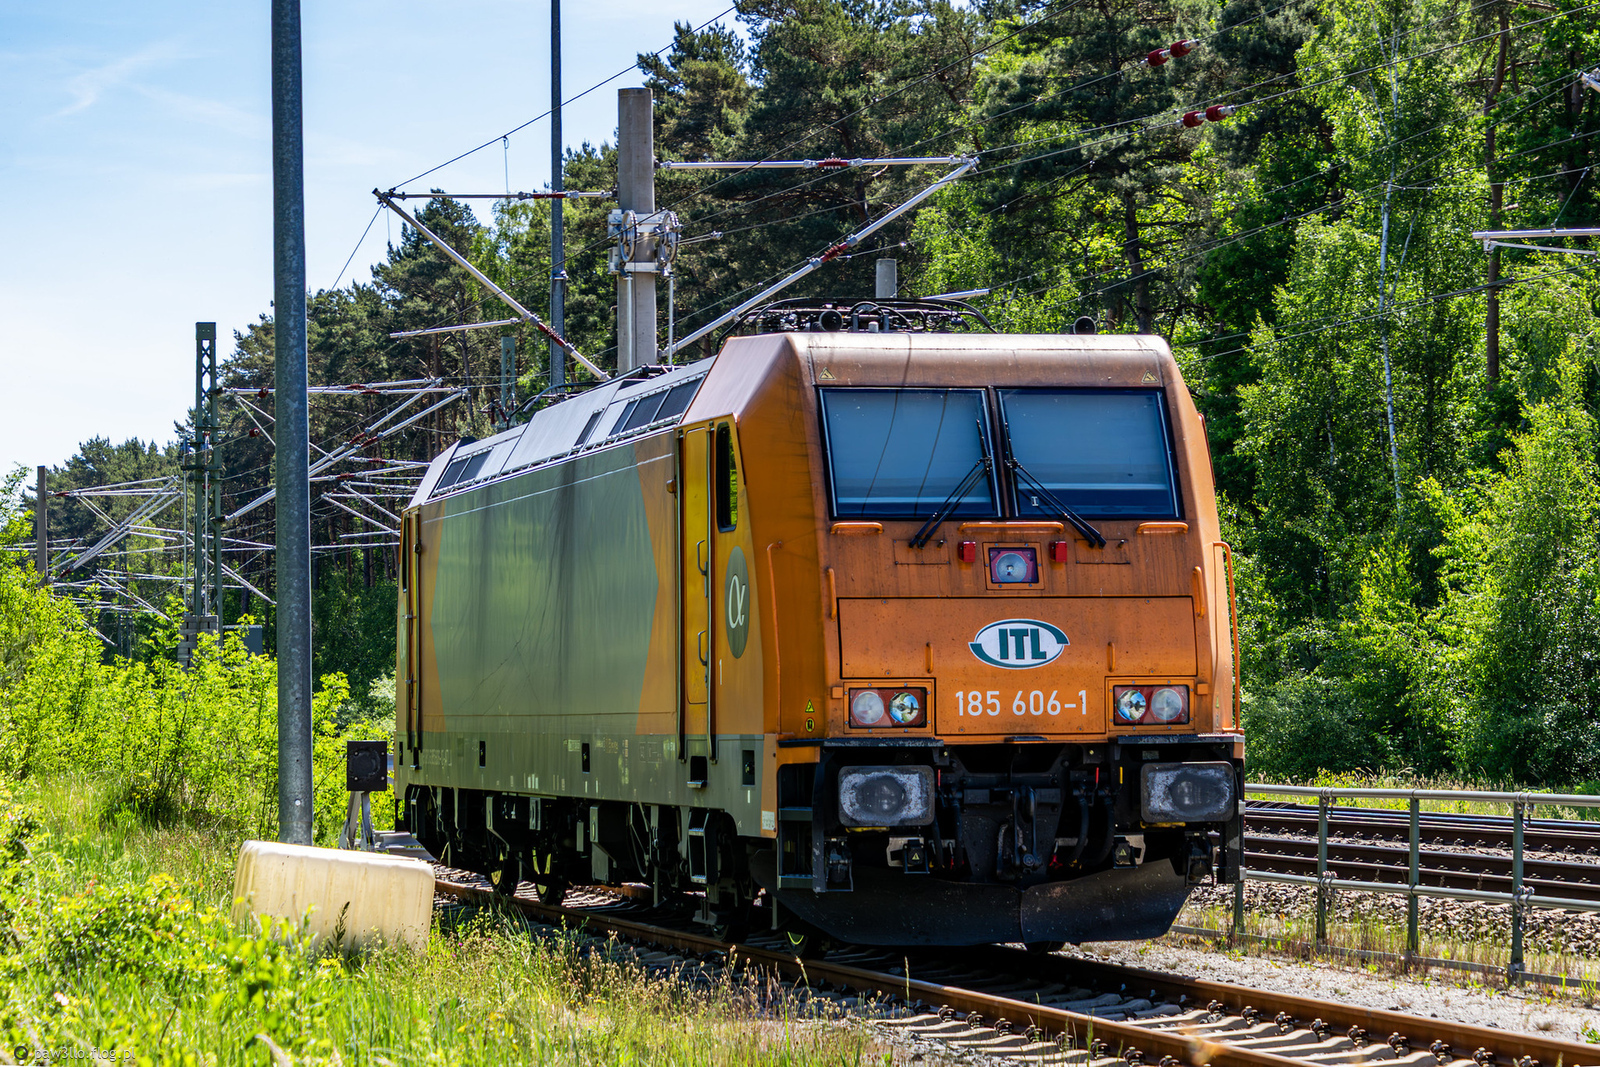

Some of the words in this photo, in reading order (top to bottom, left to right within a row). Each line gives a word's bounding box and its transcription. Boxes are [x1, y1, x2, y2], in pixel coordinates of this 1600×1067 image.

[998, 628, 1047, 660] ITL
[955, 690, 1001, 716] 185
[1012, 690, 1087, 716] 606-1
